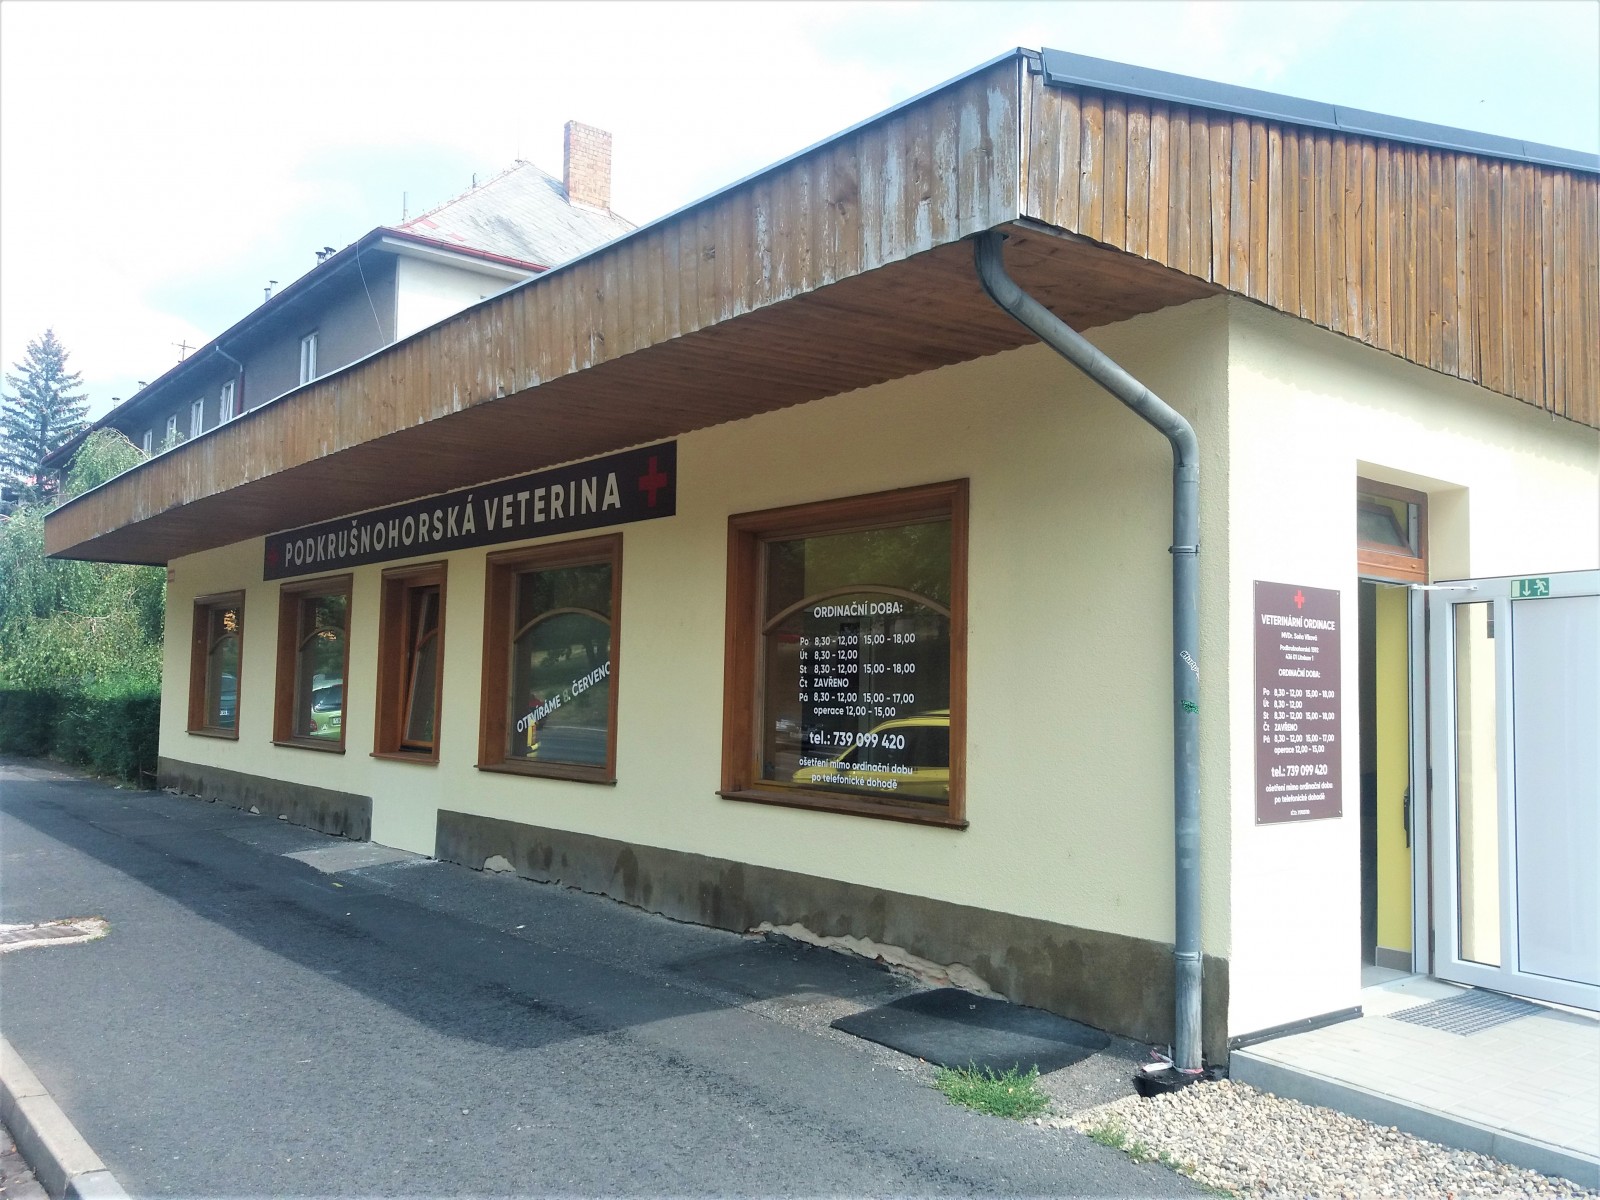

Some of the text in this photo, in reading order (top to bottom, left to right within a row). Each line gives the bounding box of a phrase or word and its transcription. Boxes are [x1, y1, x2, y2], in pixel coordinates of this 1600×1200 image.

[285, 472, 622, 568] PODKRUŠNOHORSKÁ VETERINA
[813, 601, 903, 618] ORDINAČNÍ DOBA:
[1261, 614, 1335, 630] VETERINÁRNÍ ORDINACE
[799, 637, 809, 646] Po
[814, 636, 831, 647] 8,30
[838, 636, 857, 646] 12,00
[863, 634, 885, 645] 15,00
[893, 633, 916, 644] 18,00
[799, 649, 808, 660] Út
[814, 650, 831, 661] 8,30
[838, 650, 857, 660] 12,00
[799, 665, 807, 673] St
[814, 665, 830, 675] 8,30
[837, 664, 857, 674] 12,00
[863, 664, 885, 674] 15,00
[893, 664, 916, 674] 18,00
[1278, 668, 1305, 677] ORDINAČNÍ
[799, 677, 849, 688] Čt ZAVŘENO
[799, 693, 808, 702] Pá
[813, 693, 830, 703] 8,30
[837, 693, 857, 703] 12,00
[863, 693, 884, 704] 15,00
[893, 693, 915, 704] 17,00
[1263, 688, 1270, 696] Po
[1290, 689, 1302, 698] 12,00
[1306, 690, 1318, 698] 15,00
[1290, 700, 1302, 709] 12,00
[516, 694, 561, 733] OTVÍRÁME
[813, 708, 844, 717] operace
[846, 706, 866, 716] 12,00
[874, 707, 896, 717] 15,00
[1290, 712, 1302, 720] 12,00
[1306, 712, 1318, 720] 15,00
[1274, 722, 1298, 731] ZAVŘENO
[809, 731, 905, 750] tel.: 739 099 420
[1290, 734, 1302, 743] 12,00
[1306, 734, 1318, 743] 15,00
[1274, 747, 1295, 755] operace
[1295, 745, 1308, 754] 12,00
[1312, 745, 1324, 753] 15,00
[799, 757, 913, 774] ošetření mimo ordinační dobu
[1271, 764, 1327, 777] tel.: 739 099 420
[811, 773, 897, 789] po telefonické dohodě
[1274, 796, 1281, 805] po
